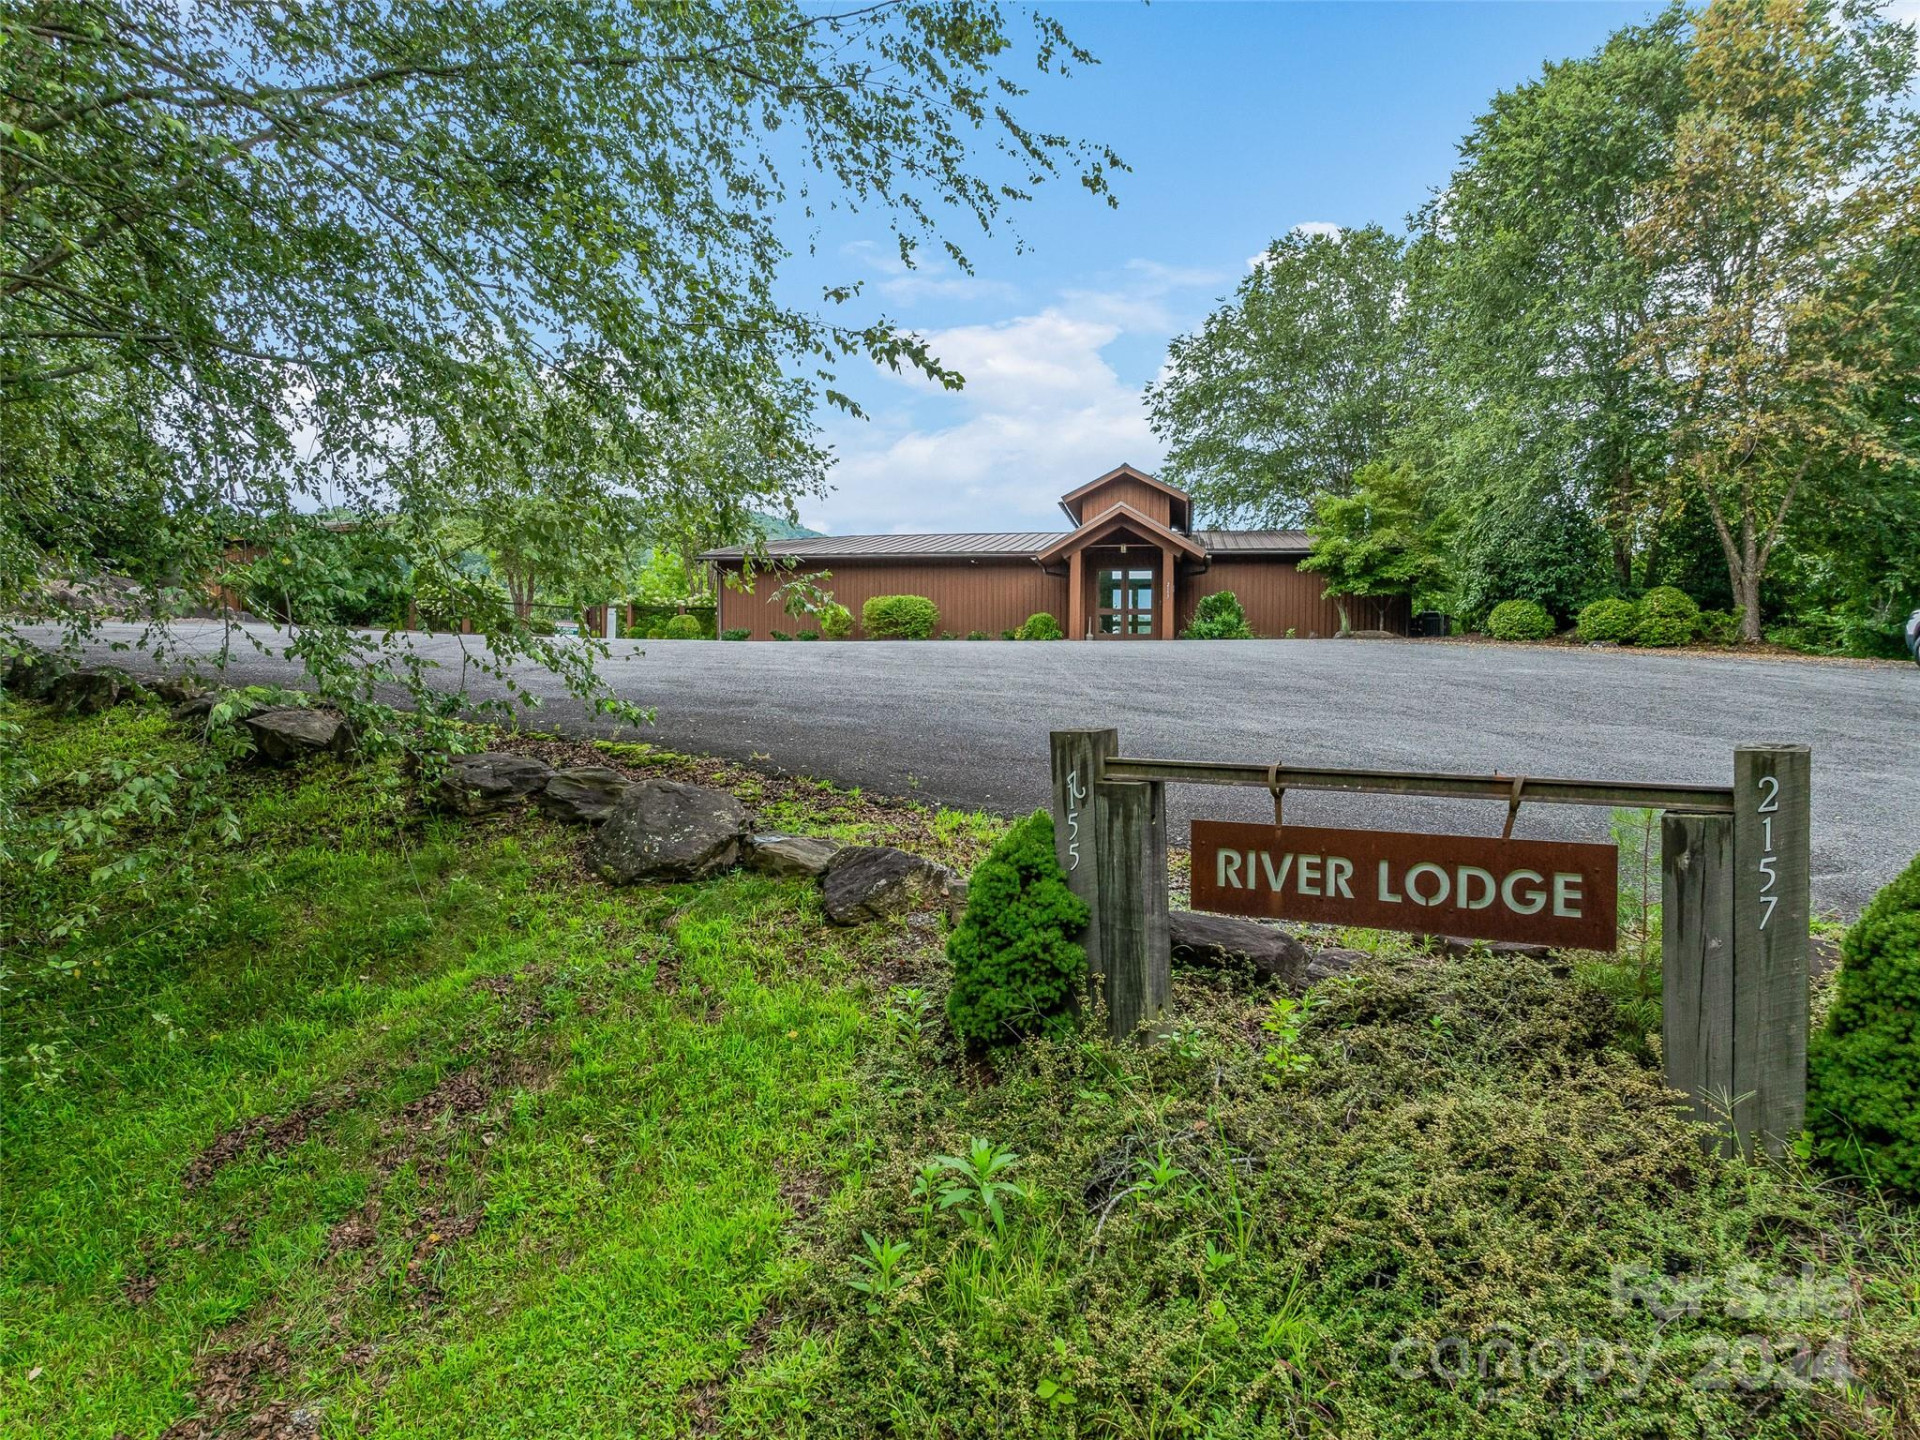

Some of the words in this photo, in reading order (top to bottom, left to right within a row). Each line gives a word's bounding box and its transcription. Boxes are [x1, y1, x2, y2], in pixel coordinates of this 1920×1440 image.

[1216, 848, 1355, 899] RIVER
[1378, 859, 1584, 919] LODGE
[1757, 776, 1779, 930] 2157
